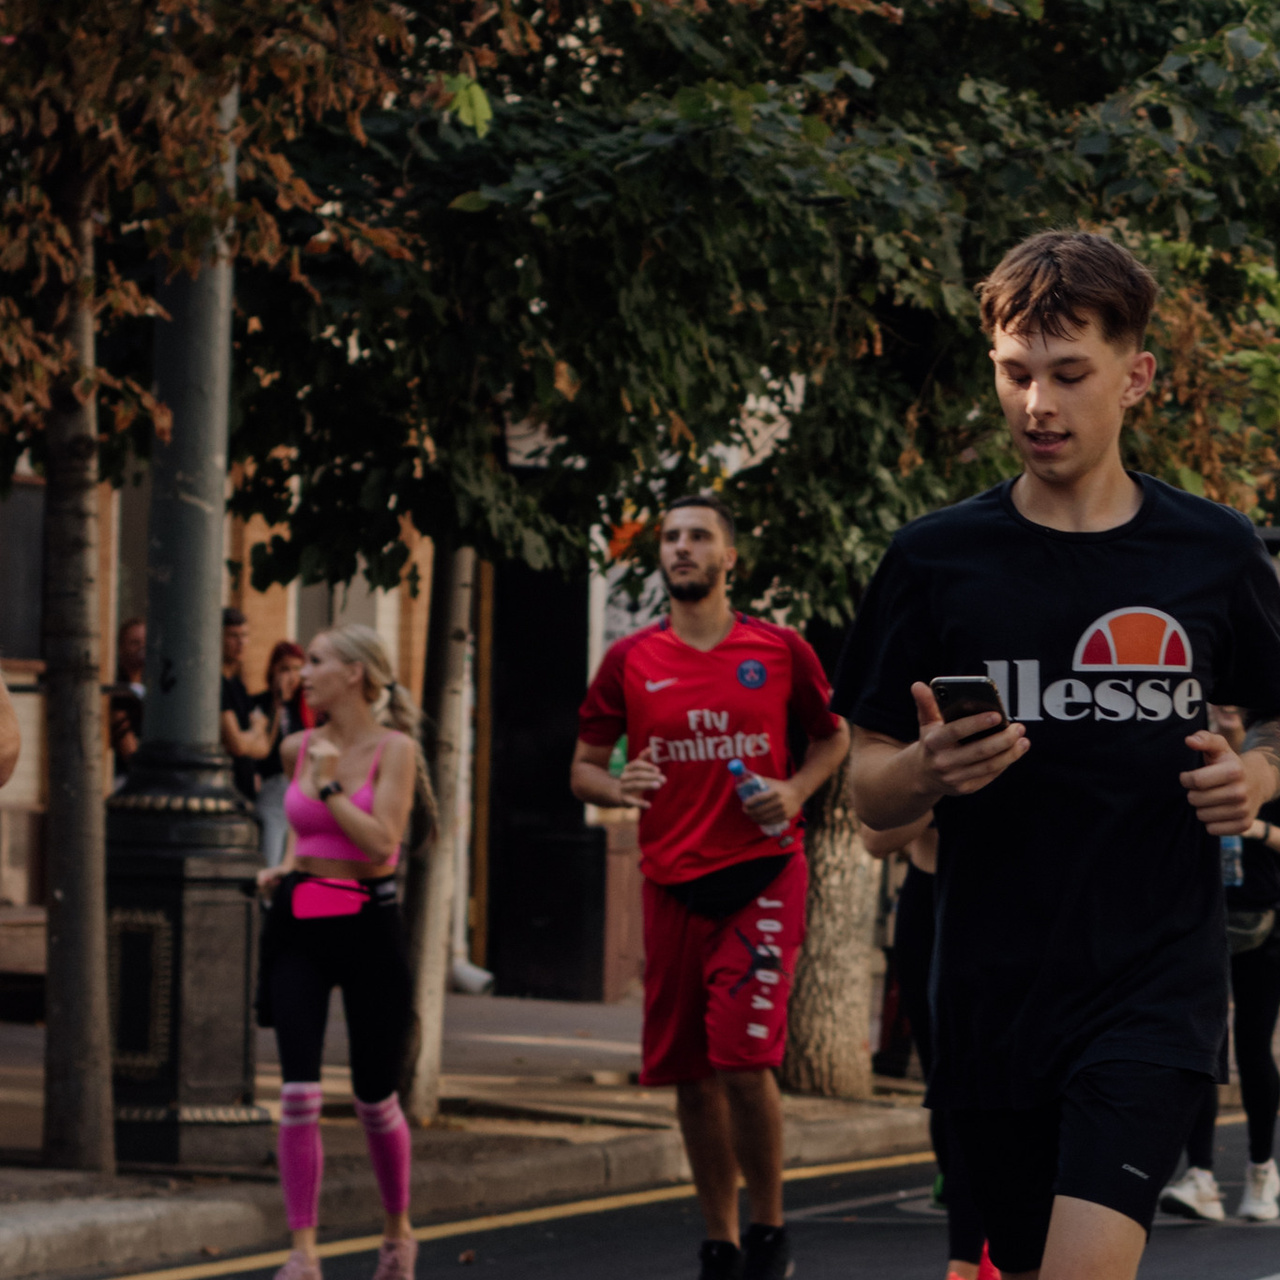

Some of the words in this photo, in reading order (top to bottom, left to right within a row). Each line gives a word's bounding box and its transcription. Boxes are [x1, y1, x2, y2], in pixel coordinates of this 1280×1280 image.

[983, 659, 1202, 721] llesse
[687, 709, 729, 732] Fly
[649, 732, 769, 763] Emirates
